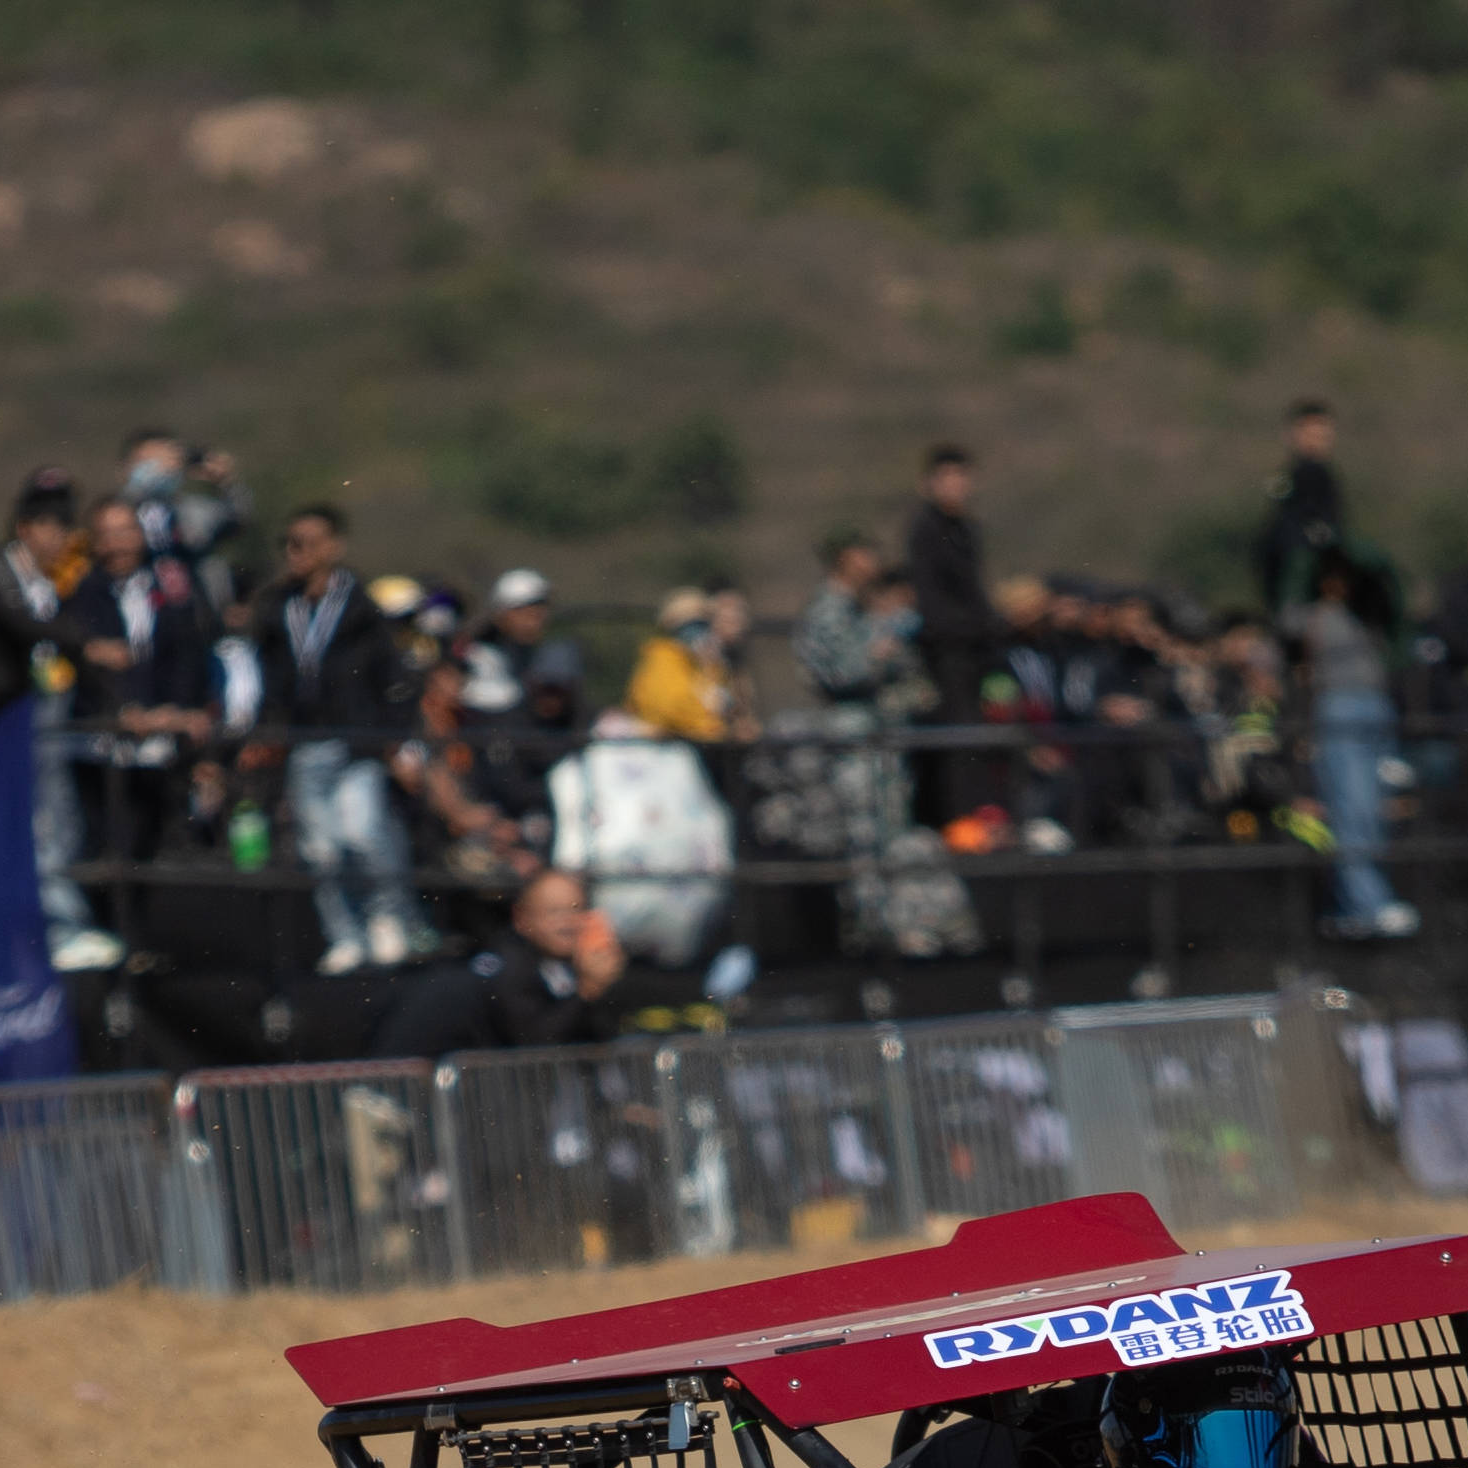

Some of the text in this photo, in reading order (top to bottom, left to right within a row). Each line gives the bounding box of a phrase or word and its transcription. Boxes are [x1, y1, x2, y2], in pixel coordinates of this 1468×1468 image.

[934, 1274, 1293, 1362] RYDANZ
[1117, 1308, 1304, 1359] 雷登轮胎
[1230, 1386, 1275, 1403] Stilo
